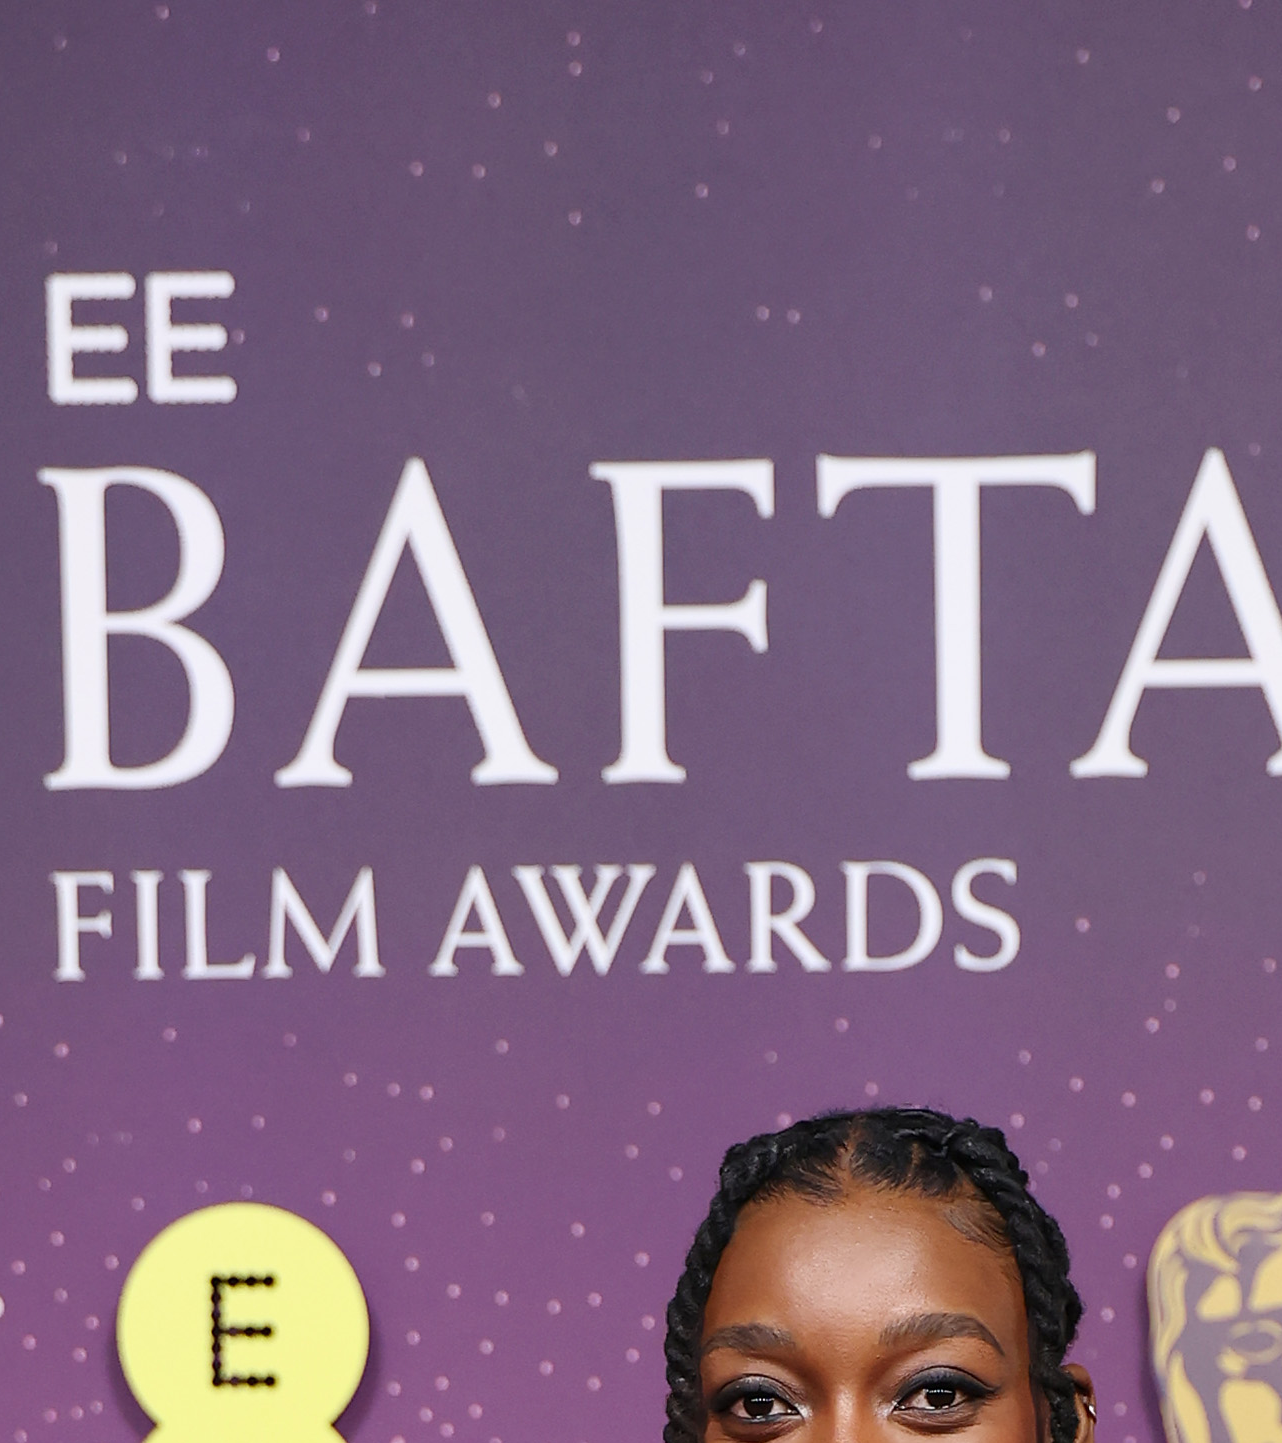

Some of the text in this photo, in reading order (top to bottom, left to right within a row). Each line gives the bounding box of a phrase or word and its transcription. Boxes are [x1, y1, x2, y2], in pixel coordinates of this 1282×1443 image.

[47, 272, 238, 405] EE
[53, 858, 1021, 981] FILM AWARDS
